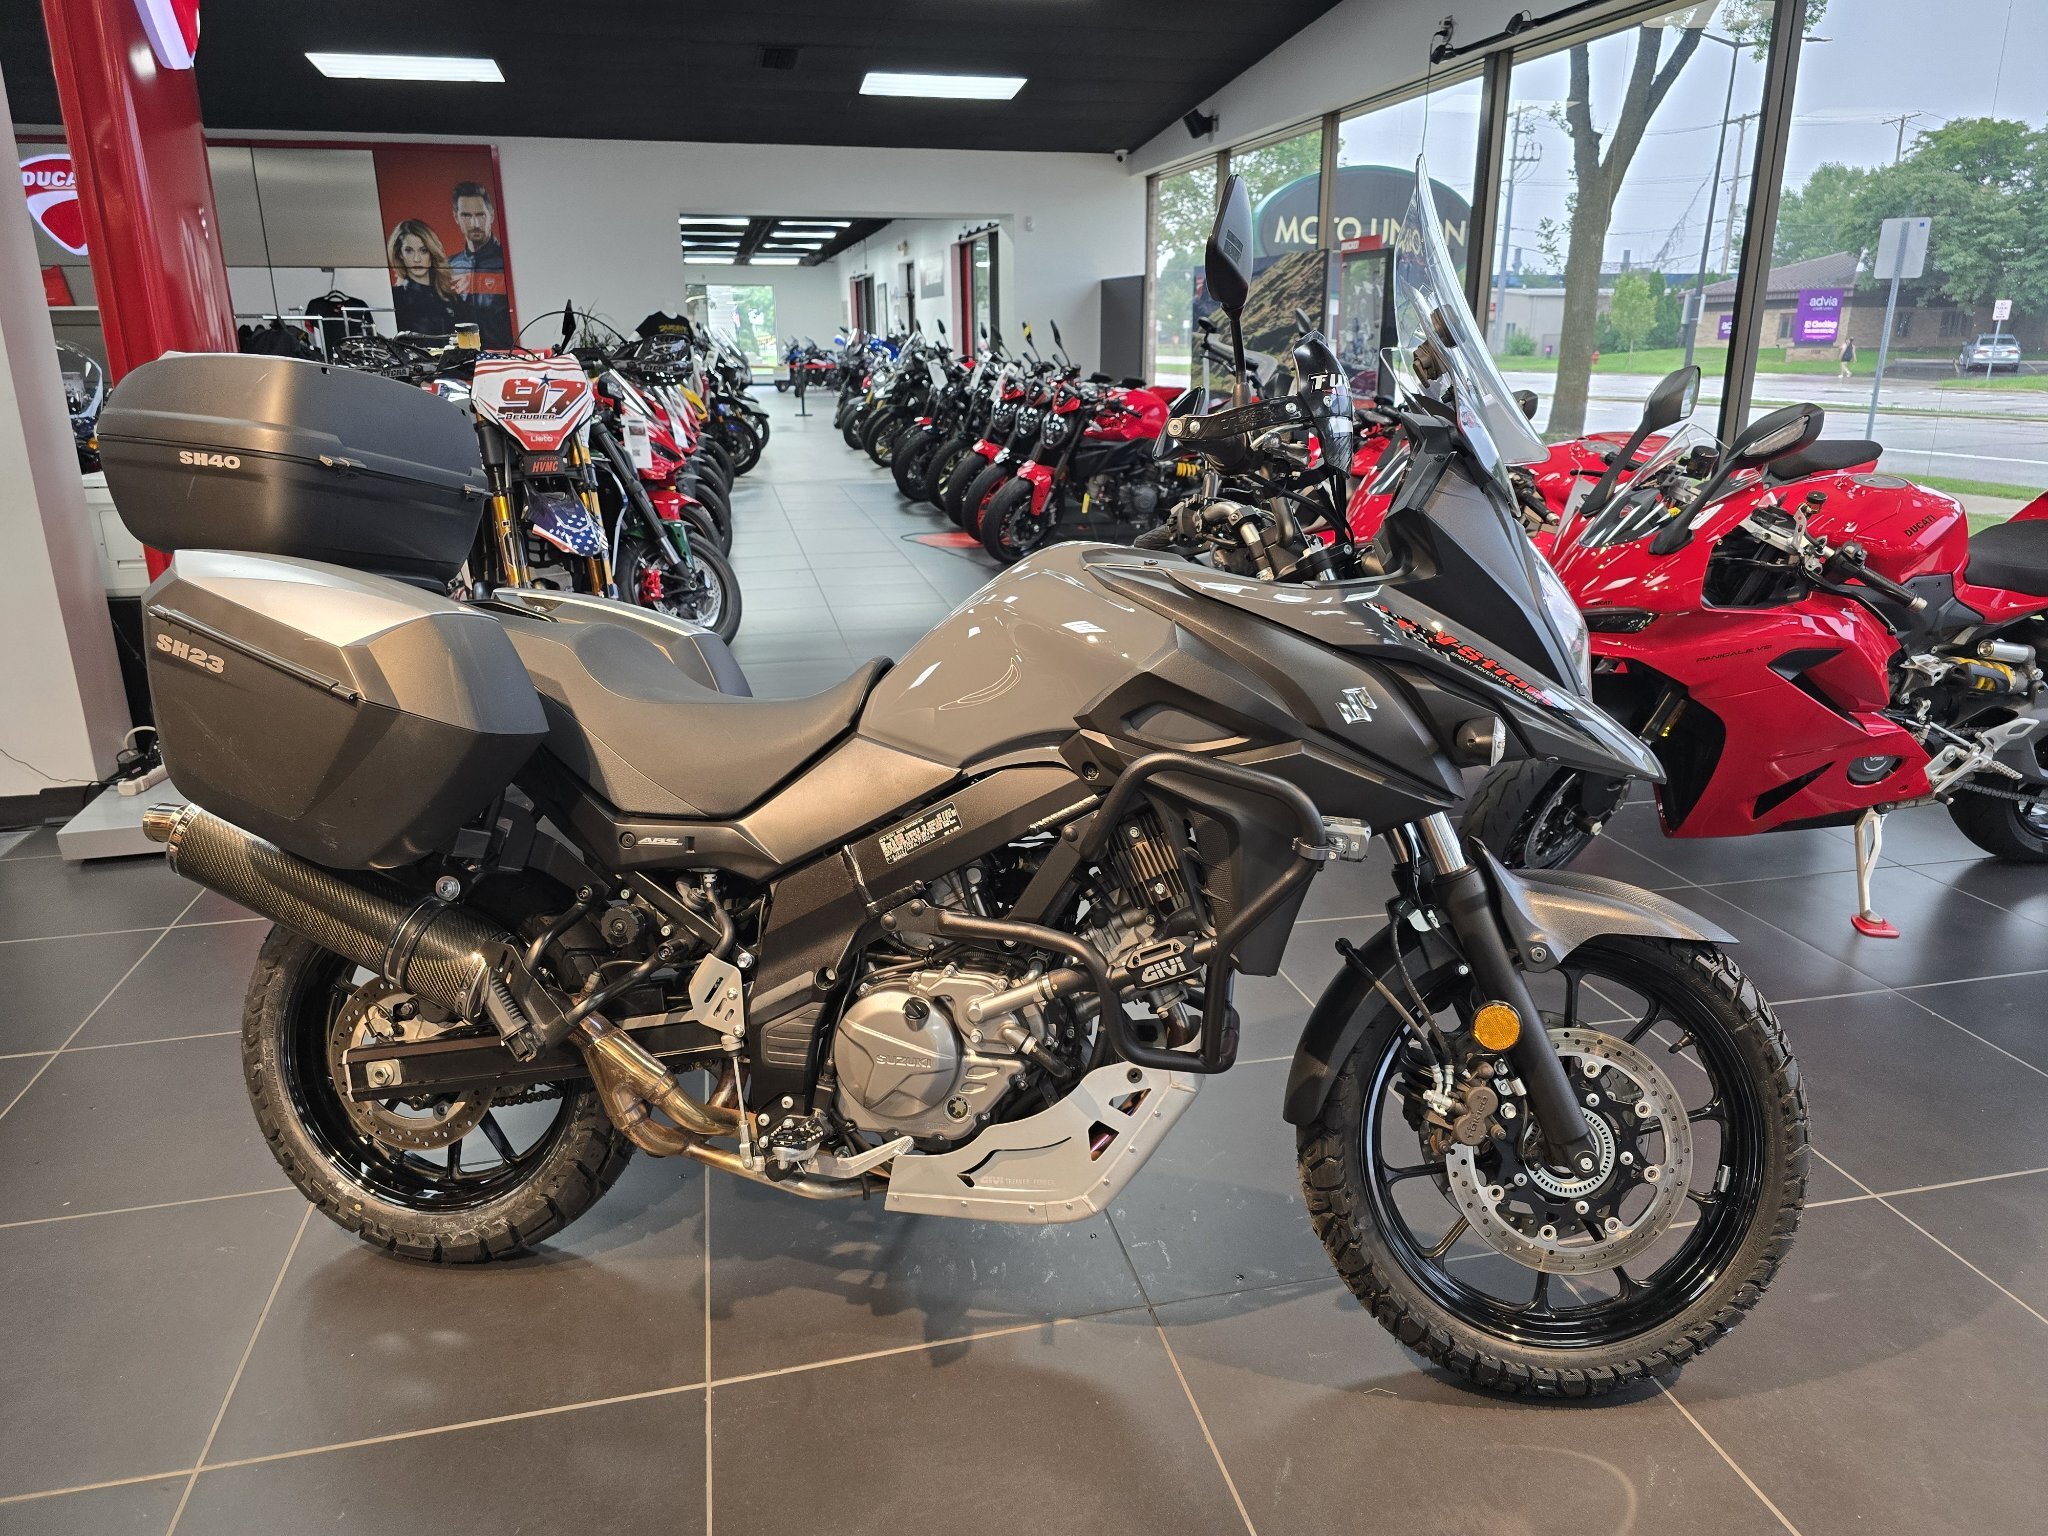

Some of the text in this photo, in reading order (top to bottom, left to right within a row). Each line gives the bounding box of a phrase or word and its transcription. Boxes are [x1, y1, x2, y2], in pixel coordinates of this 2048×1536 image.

[22, 171, 76, 187] DUCA
[1274, 215, 1362, 245] MOO
[1809, 296, 1838, 307] advia
[498, 377, 587, 414] 97
[180, 450, 241, 469] SH40
[532, 461, 559, 473] HVMC
[1904, 514, 1936, 537] DUCATI
[156, 633, 225, 674] SH23
[1449, 651, 1538, 704] SPORT ADVENTURE TOURER
[1141, 956, 1187, 982] GIVI
[876, 1055, 931, 1068] SUZUKI
